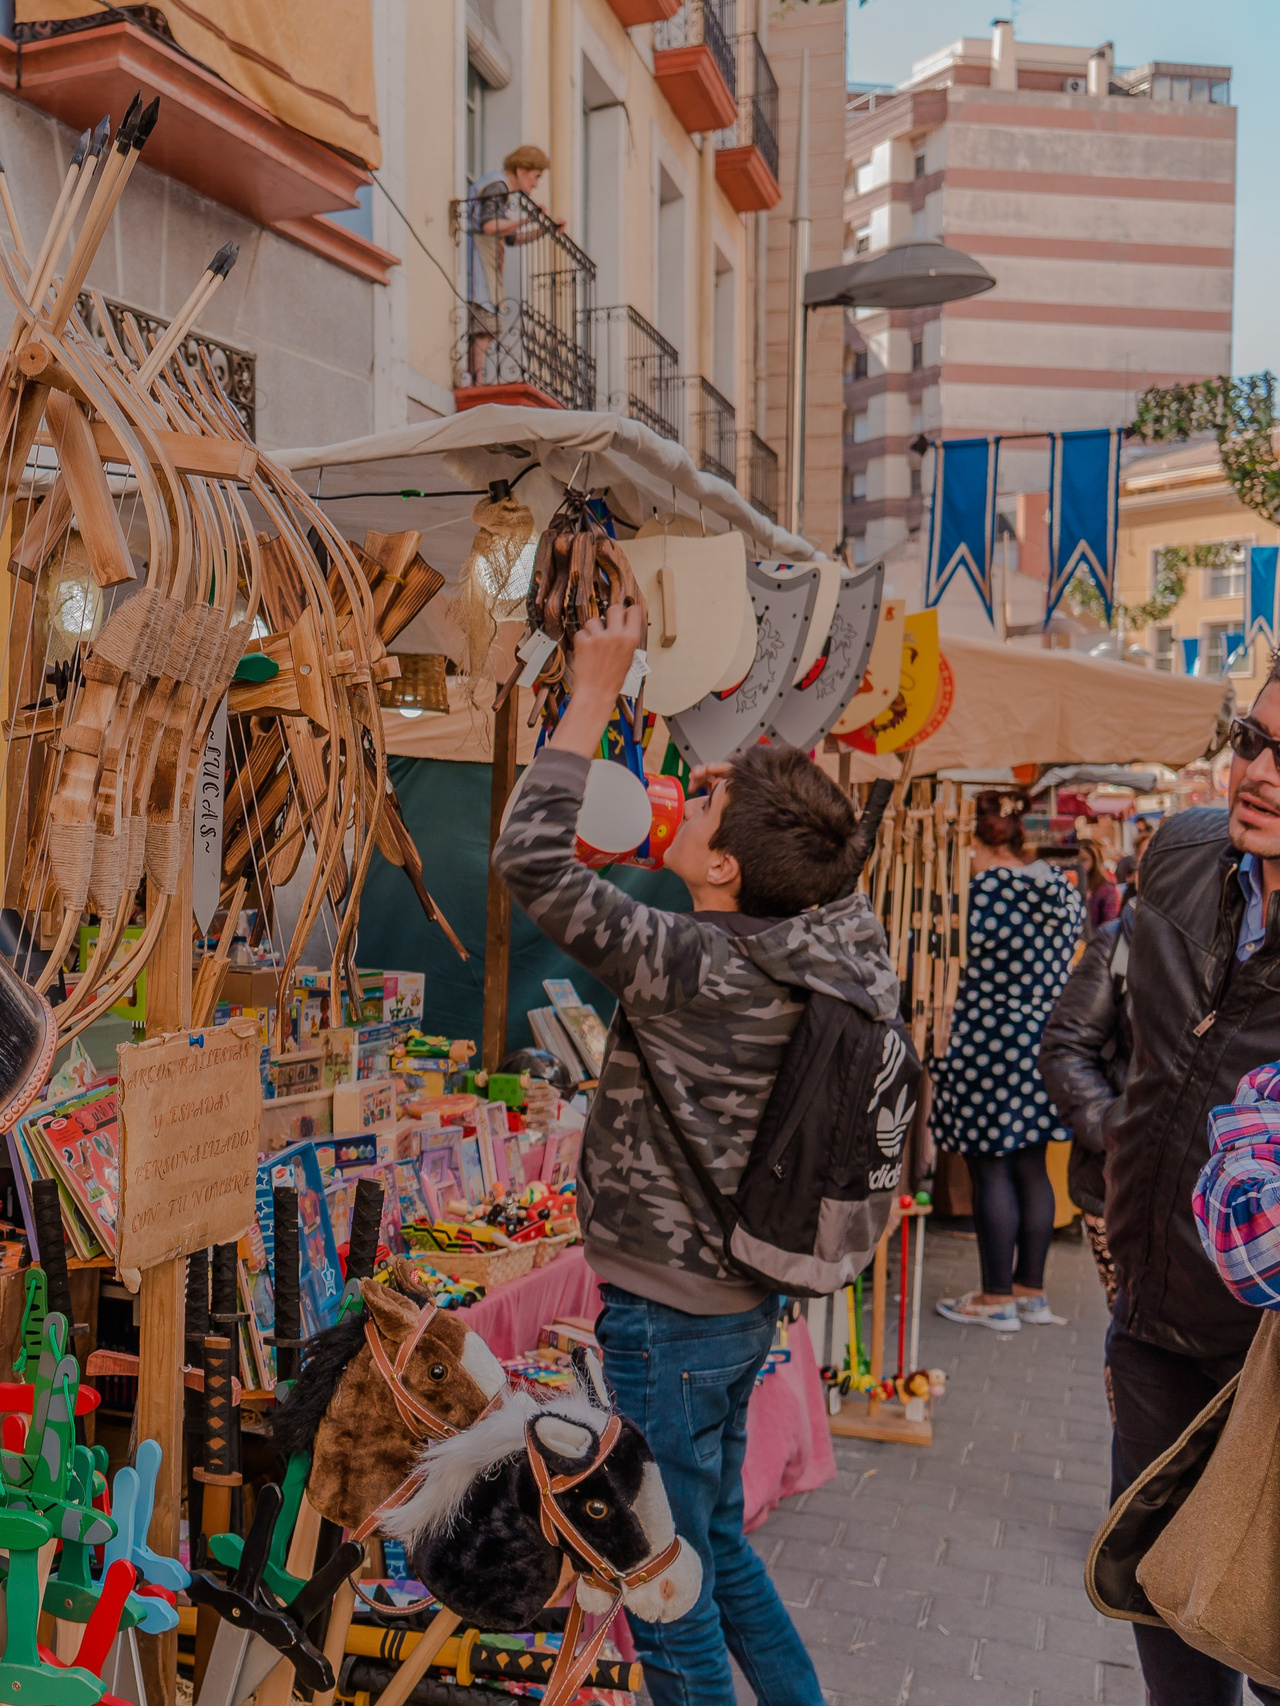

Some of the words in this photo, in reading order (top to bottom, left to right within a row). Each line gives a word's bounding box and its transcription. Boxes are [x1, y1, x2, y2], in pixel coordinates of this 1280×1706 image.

[200, 743, 221, 838] LUCAS
[169, 1090, 230, 1125] ESPADAS
[131, 1202, 160, 1234] CON
[191, 1169, 252, 1207] NOMBRE
